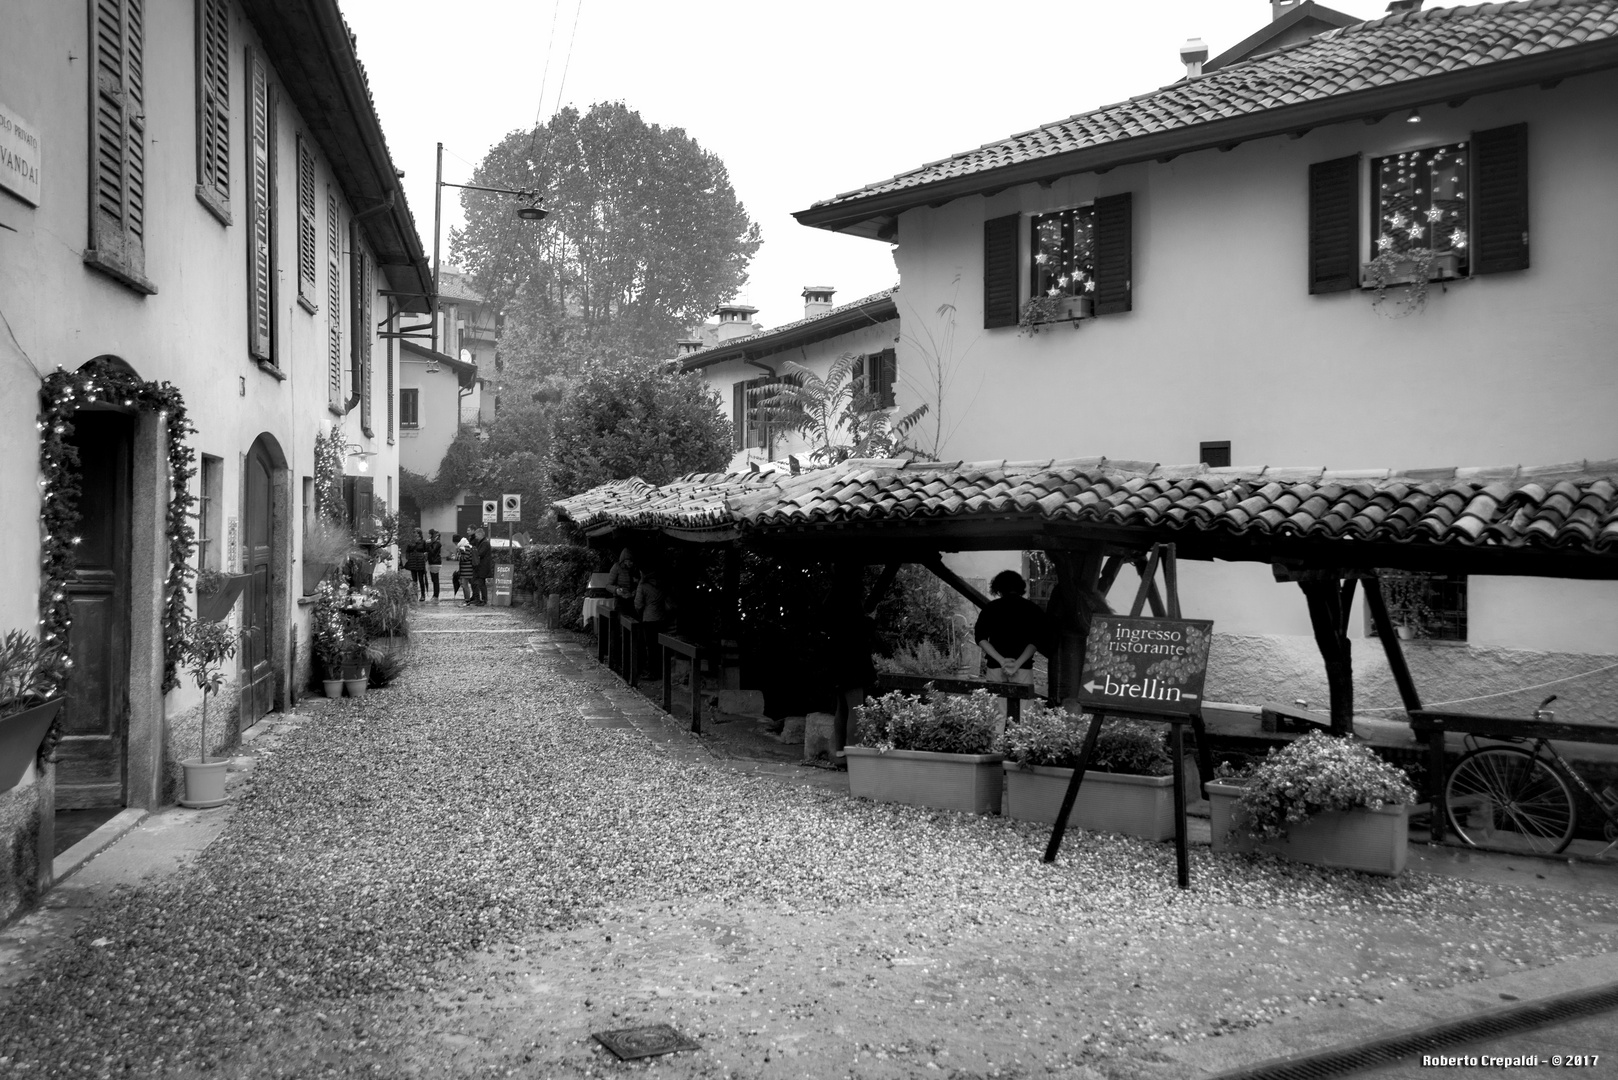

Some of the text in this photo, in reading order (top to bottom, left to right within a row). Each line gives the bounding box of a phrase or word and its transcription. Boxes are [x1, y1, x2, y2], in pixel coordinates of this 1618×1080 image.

[14, 124, 38, 149] PRIVATO
[1115, 623, 1181, 642] ingresso
[1109, 638, 1185, 656] ristorante
[1104, 674, 1181, 701] brellin
